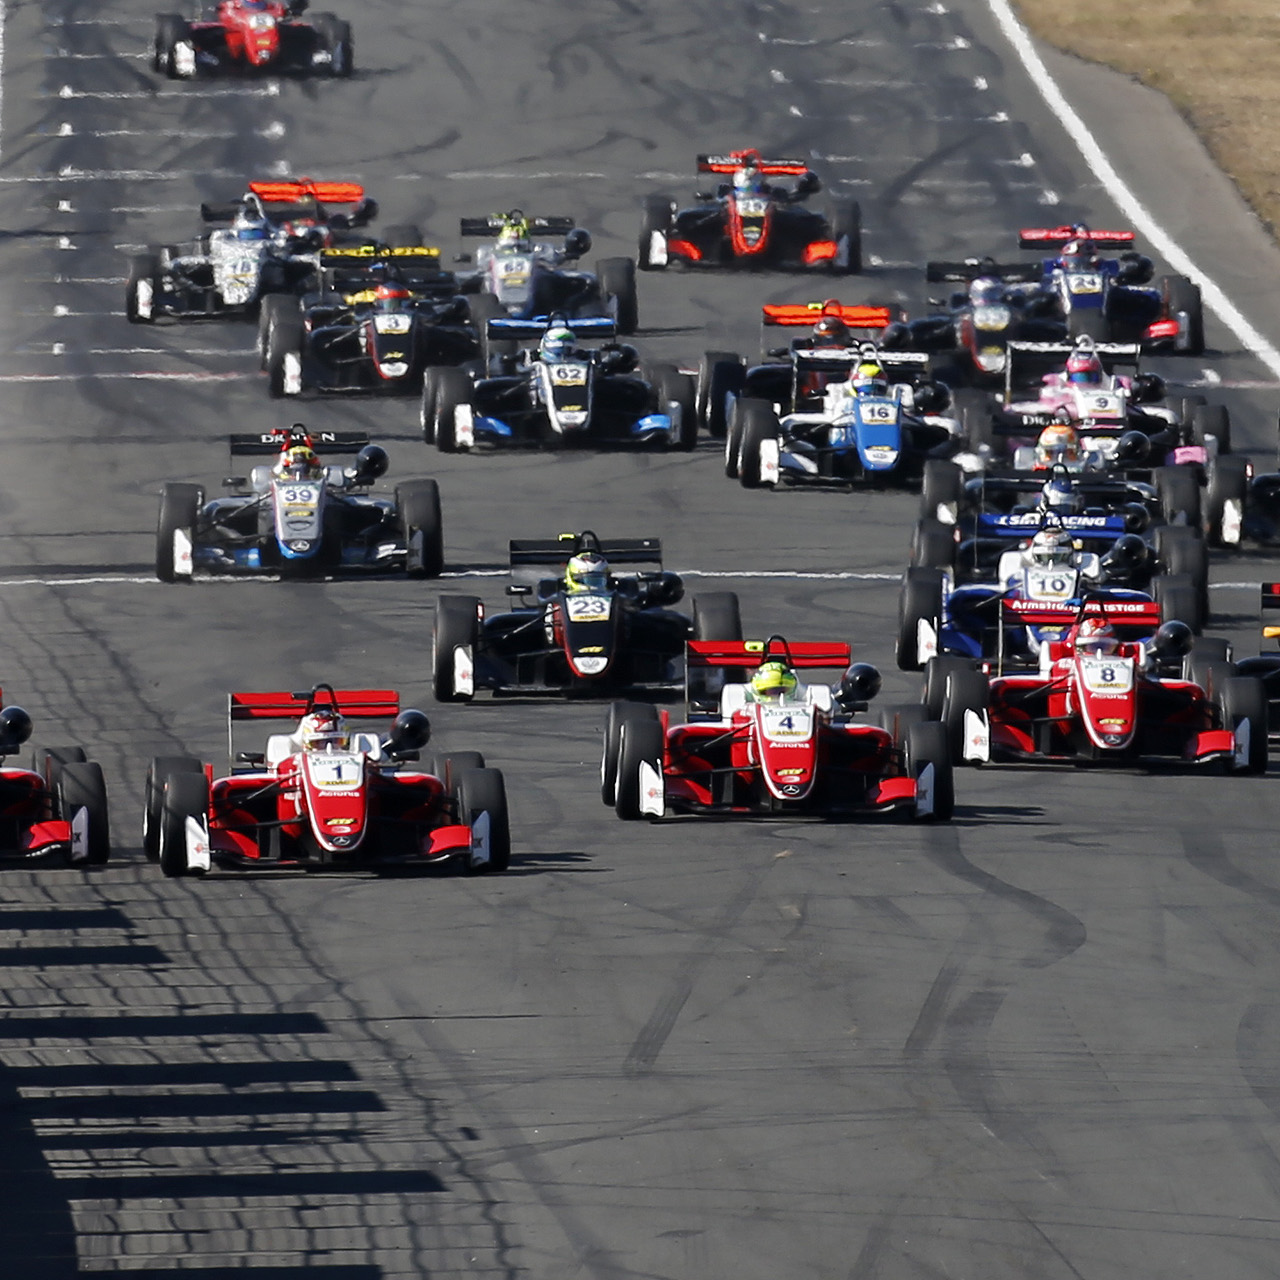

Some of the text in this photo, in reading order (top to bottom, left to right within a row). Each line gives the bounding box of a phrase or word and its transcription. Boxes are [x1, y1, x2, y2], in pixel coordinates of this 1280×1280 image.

[556, 368, 582, 380] 62
[867, 407, 890, 419] 16
[284, 490, 313, 502] 39
[1037, 580, 1066, 592] 10
[573, 600, 606, 614] 23
[1083, 602, 1145, 613] PRSTIGE
[1101, 667, 1116, 682] 8
[779, 716, 795, 729] 4
[332, 765, 343, 779] 1
